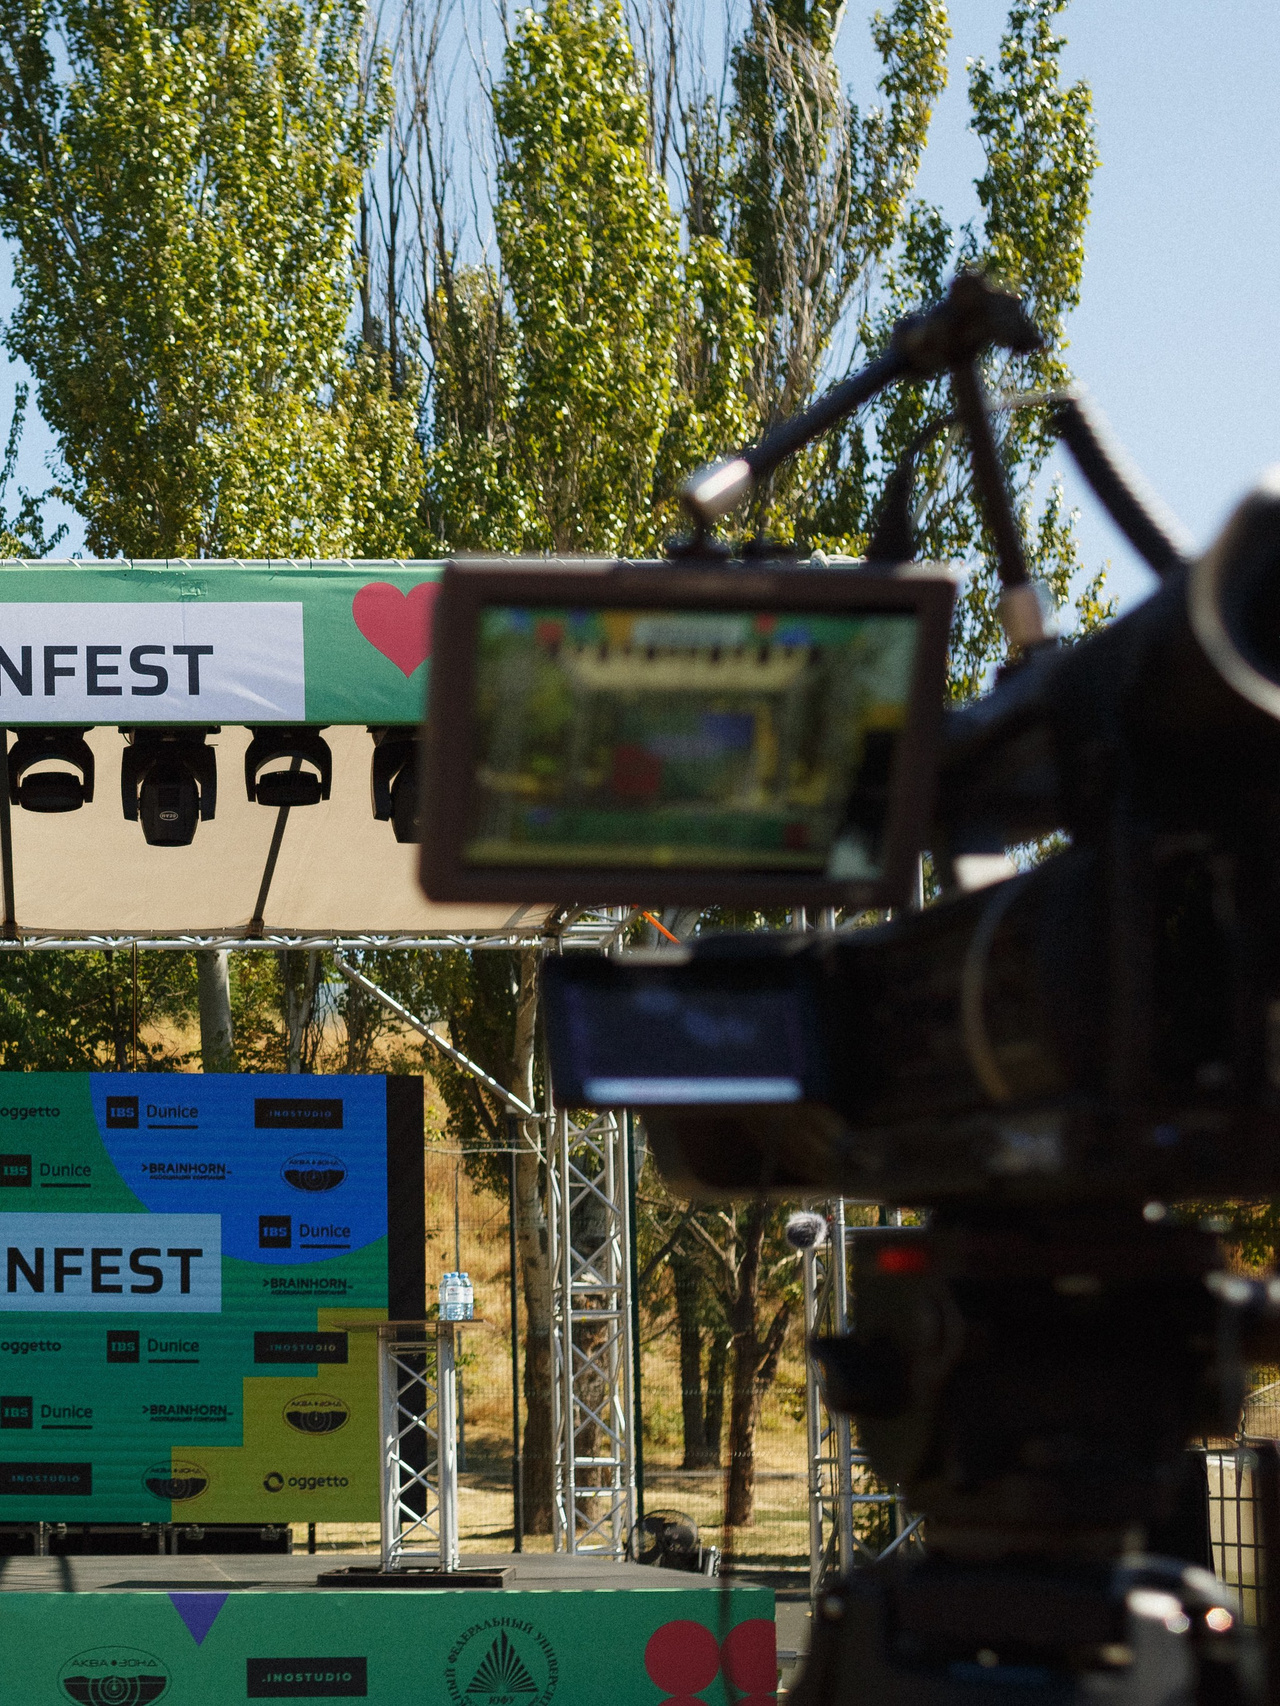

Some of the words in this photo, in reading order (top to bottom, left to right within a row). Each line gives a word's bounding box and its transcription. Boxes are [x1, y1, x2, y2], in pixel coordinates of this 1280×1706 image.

[0, 1106, 60, 1121] oggetto
[111, 1107, 134, 1117] IBS
[147, 1104, 198, 1118] Dunice
[4, 1166, 28, 1176] IBS
[40, 1163, 91, 1177] Dunice
[263, 1227, 287, 1237] IBS
[300, 1224, 351, 1238] Dunice
[1, 1339, 61, 1354] oggetto
[111, 1342, 135, 1351] IBS
[148, 1339, 199, 1353] Dunice
[5, 1408, 29, 1418] IBS
[41, 1405, 92, 1418] Dunice
[288, 1475, 349, 1489] oggetto
[448, 1617, 533, 1663] ФЕДЕРАЛЬНЫЙ
